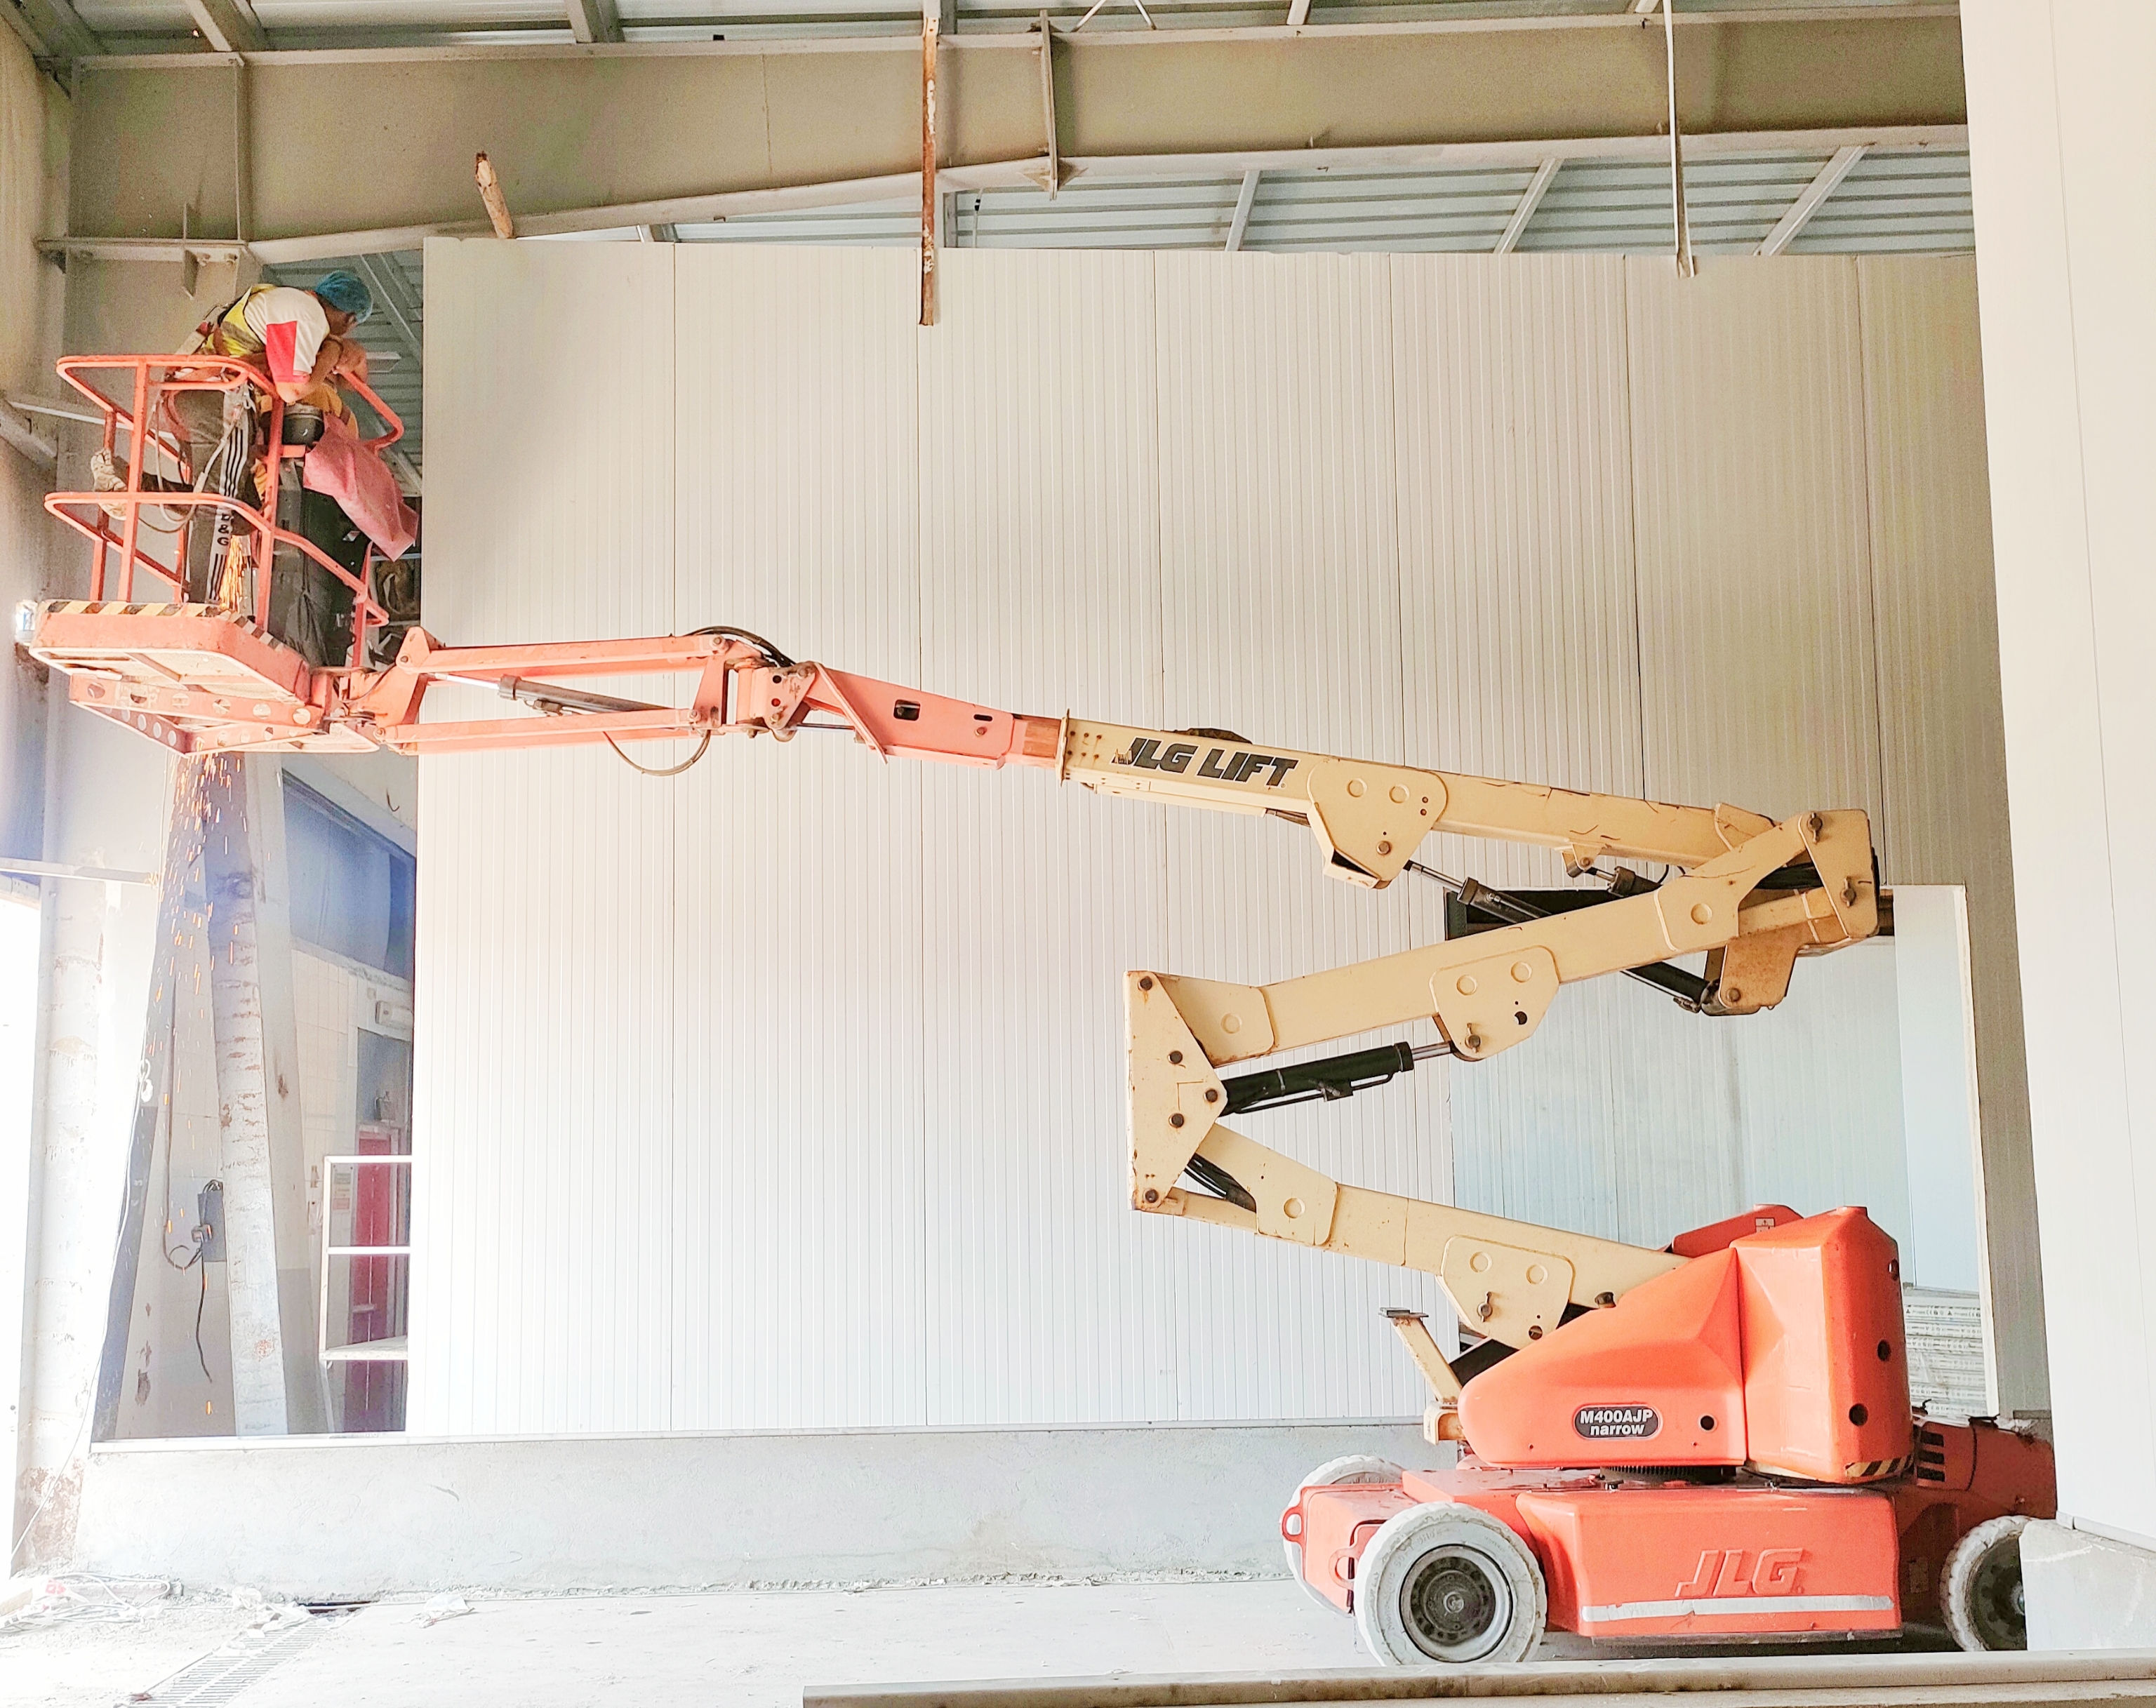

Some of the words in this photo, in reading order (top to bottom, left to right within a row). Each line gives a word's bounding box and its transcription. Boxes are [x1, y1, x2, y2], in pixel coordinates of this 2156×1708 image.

[1111, 737, 1199, 774] JLG
[1196, 748, 1299, 787] LIFT
[1580, 1409, 1653, 1424] M400AJP
[1590, 1424, 1645, 1436] narrow
[1675, 1547, 1803, 1597] JLG
